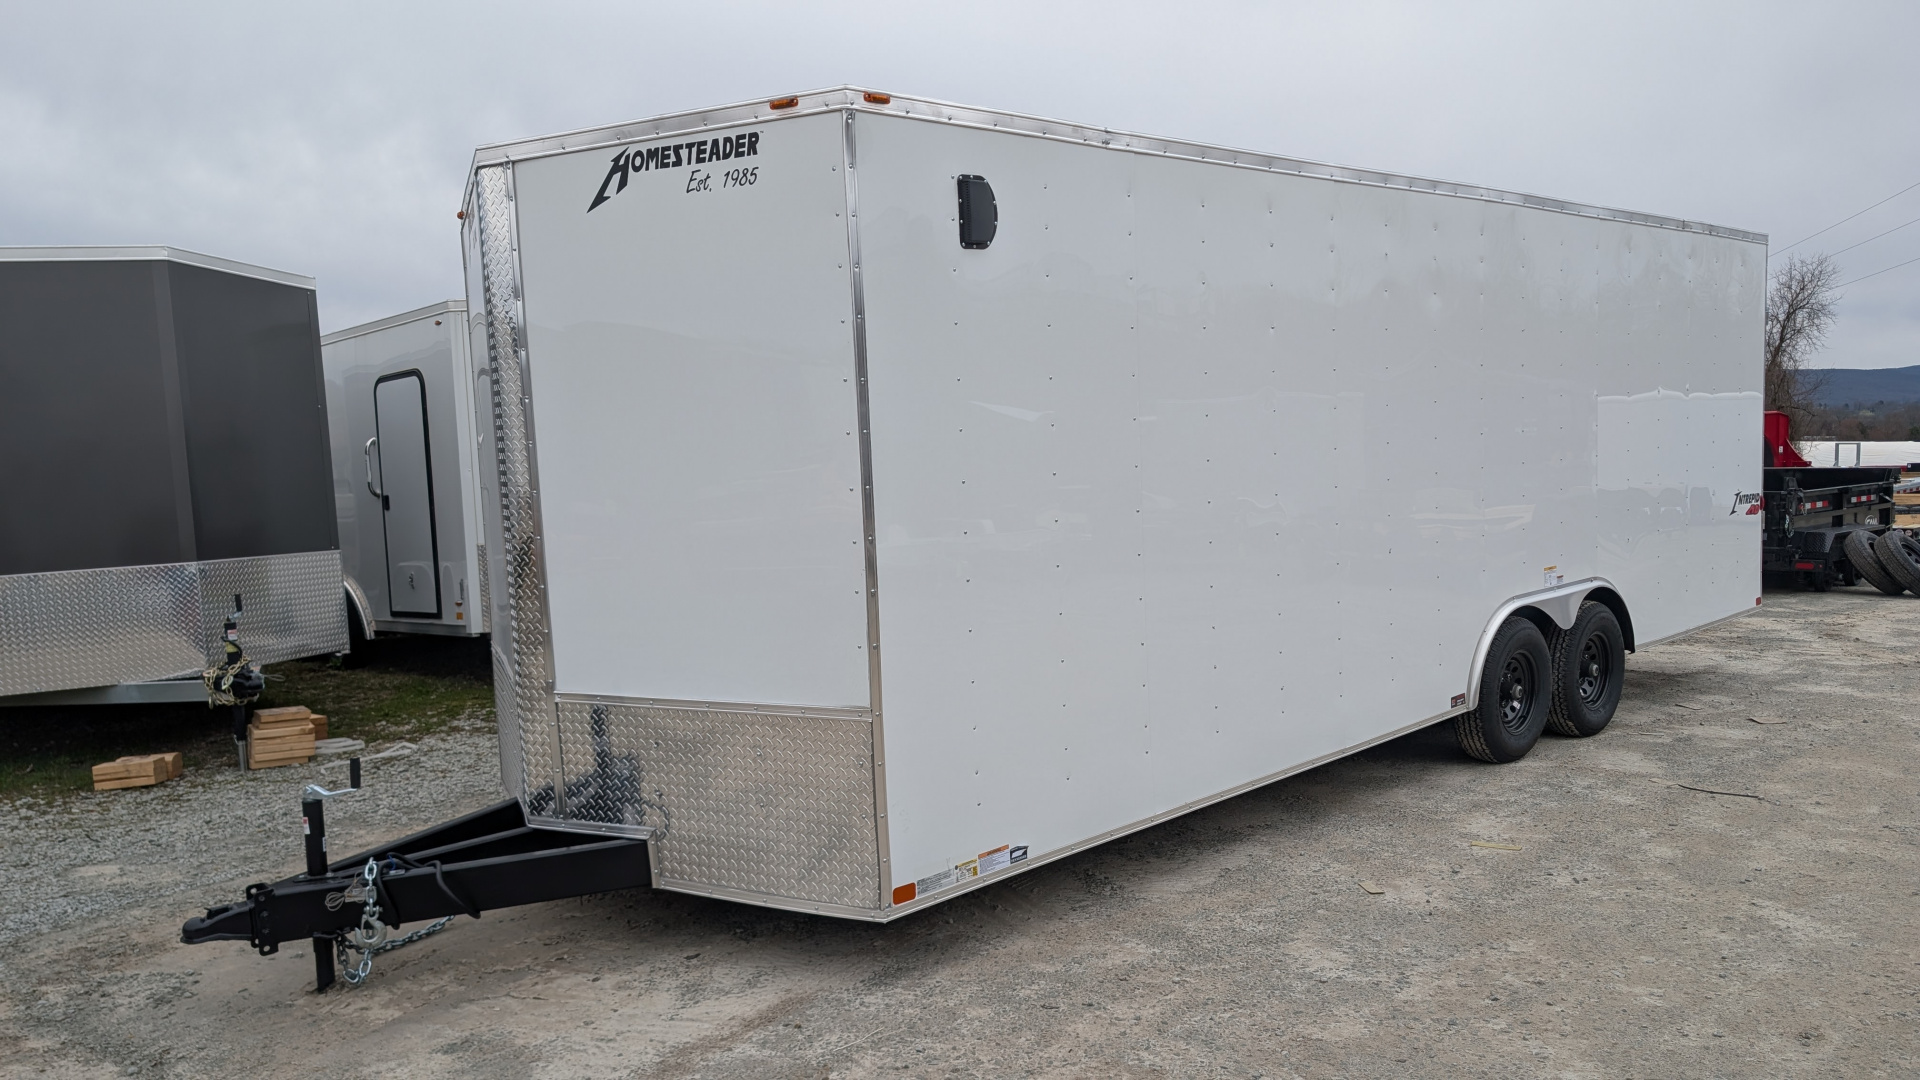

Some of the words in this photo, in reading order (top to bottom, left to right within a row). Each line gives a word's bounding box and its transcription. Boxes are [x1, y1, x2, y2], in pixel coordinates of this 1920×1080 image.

[586, 131, 760, 213] HOMESTEADER
[686, 169, 712, 194] Est.
[723, 166, 760, 188] 1985
